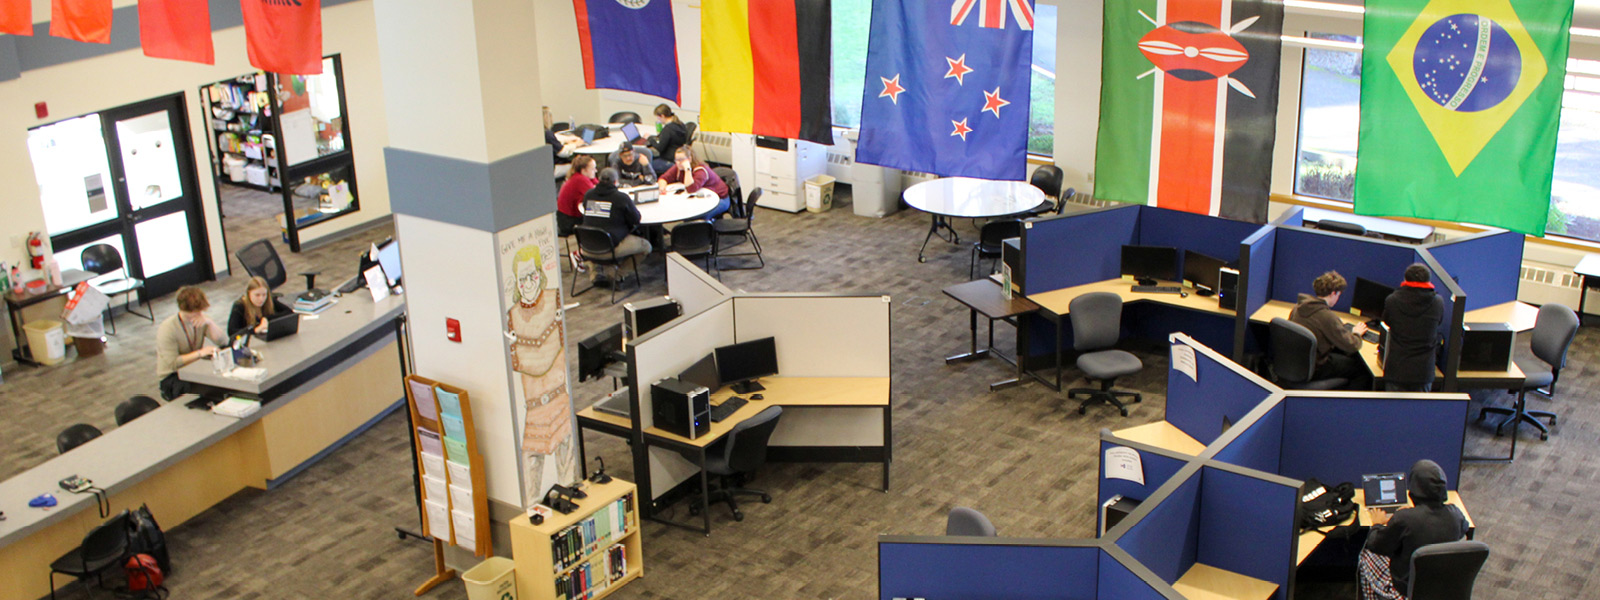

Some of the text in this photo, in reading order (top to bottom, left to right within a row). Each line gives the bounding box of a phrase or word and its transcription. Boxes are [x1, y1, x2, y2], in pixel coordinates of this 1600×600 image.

[1480, 20, 1488, 52] ORDEM
[1449, 61, 1483, 108] PROGRESSO
[501, 240, 516, 255] GIVE
[517, 234, 526, 244] ME
[528, 232, 534, 240] A
